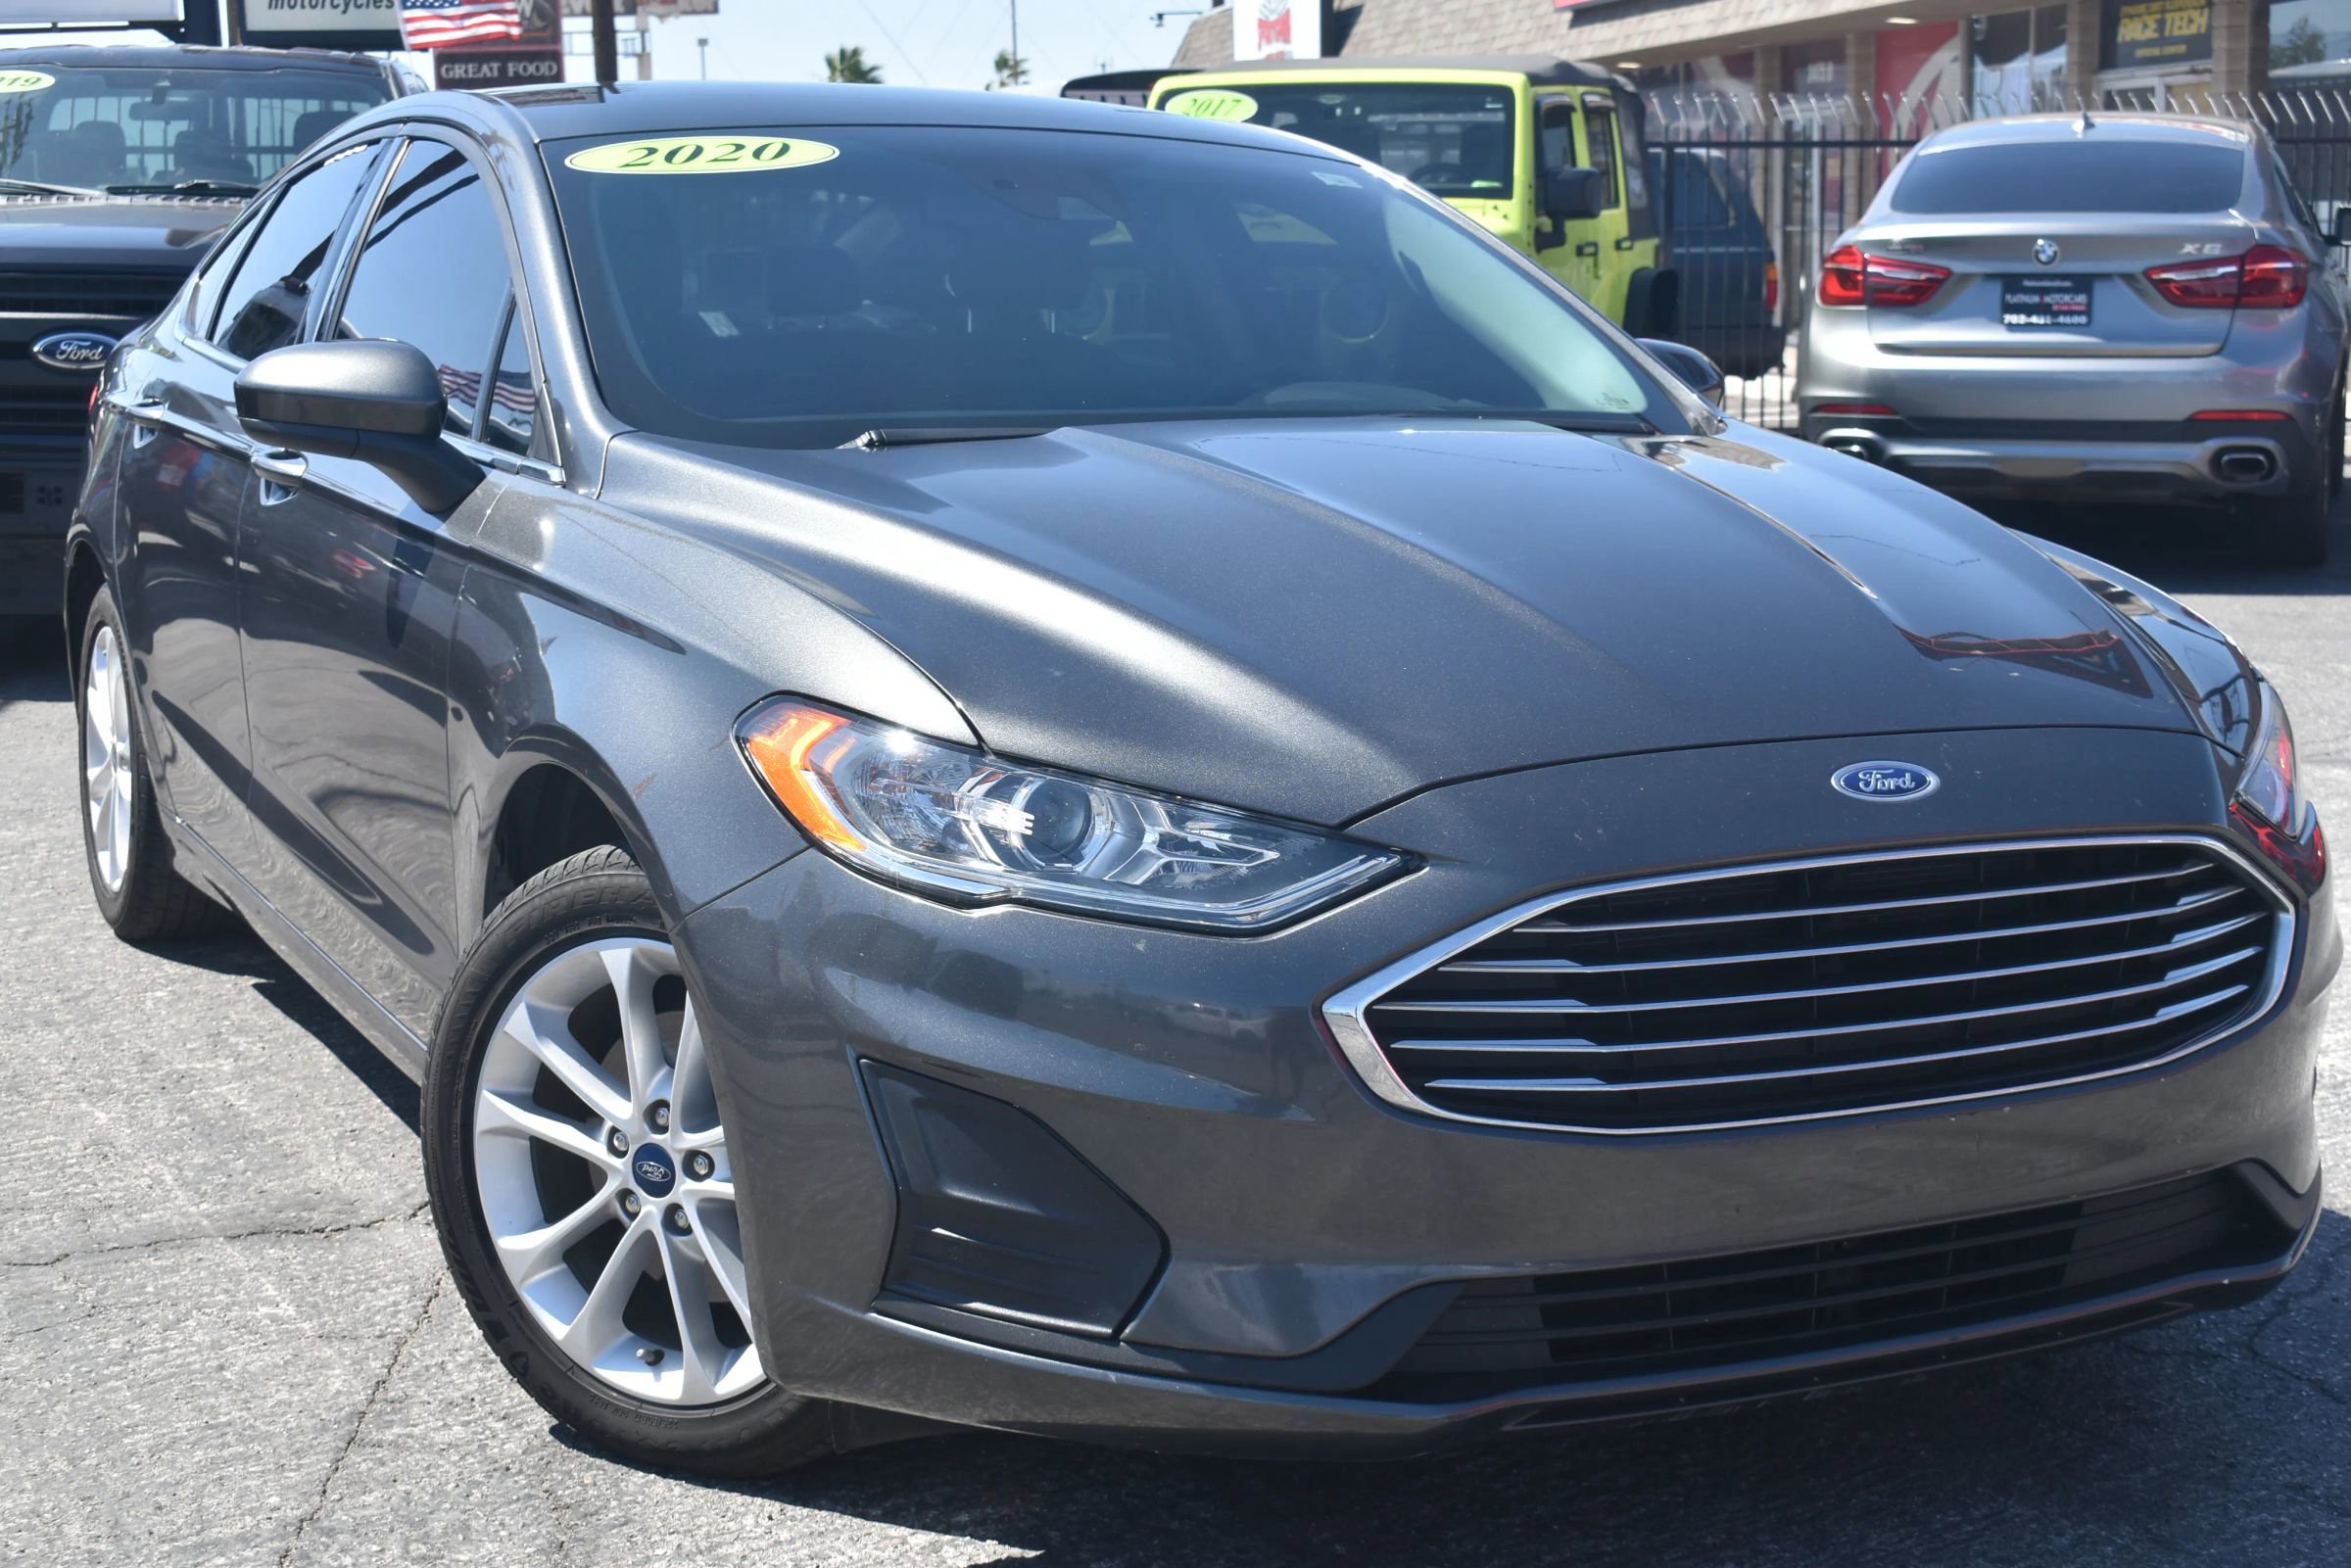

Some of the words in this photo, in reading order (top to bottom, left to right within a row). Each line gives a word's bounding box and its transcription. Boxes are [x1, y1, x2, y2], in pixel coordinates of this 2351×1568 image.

[267, 0, 396, 15] motorcycles
[2164, 8, 2209, 36] TECH
[440, 63, 502, 79] GREAT
[506, 61, 558, 77] FOOD
[1181, 98, 1242, 118] 2017
[617, 141, 791, 168] 2020
[56, 339, 104, 360] Ford
[1858, 769, 1916, 792] Ford
[641, 1164, 665, 1180] Ford
